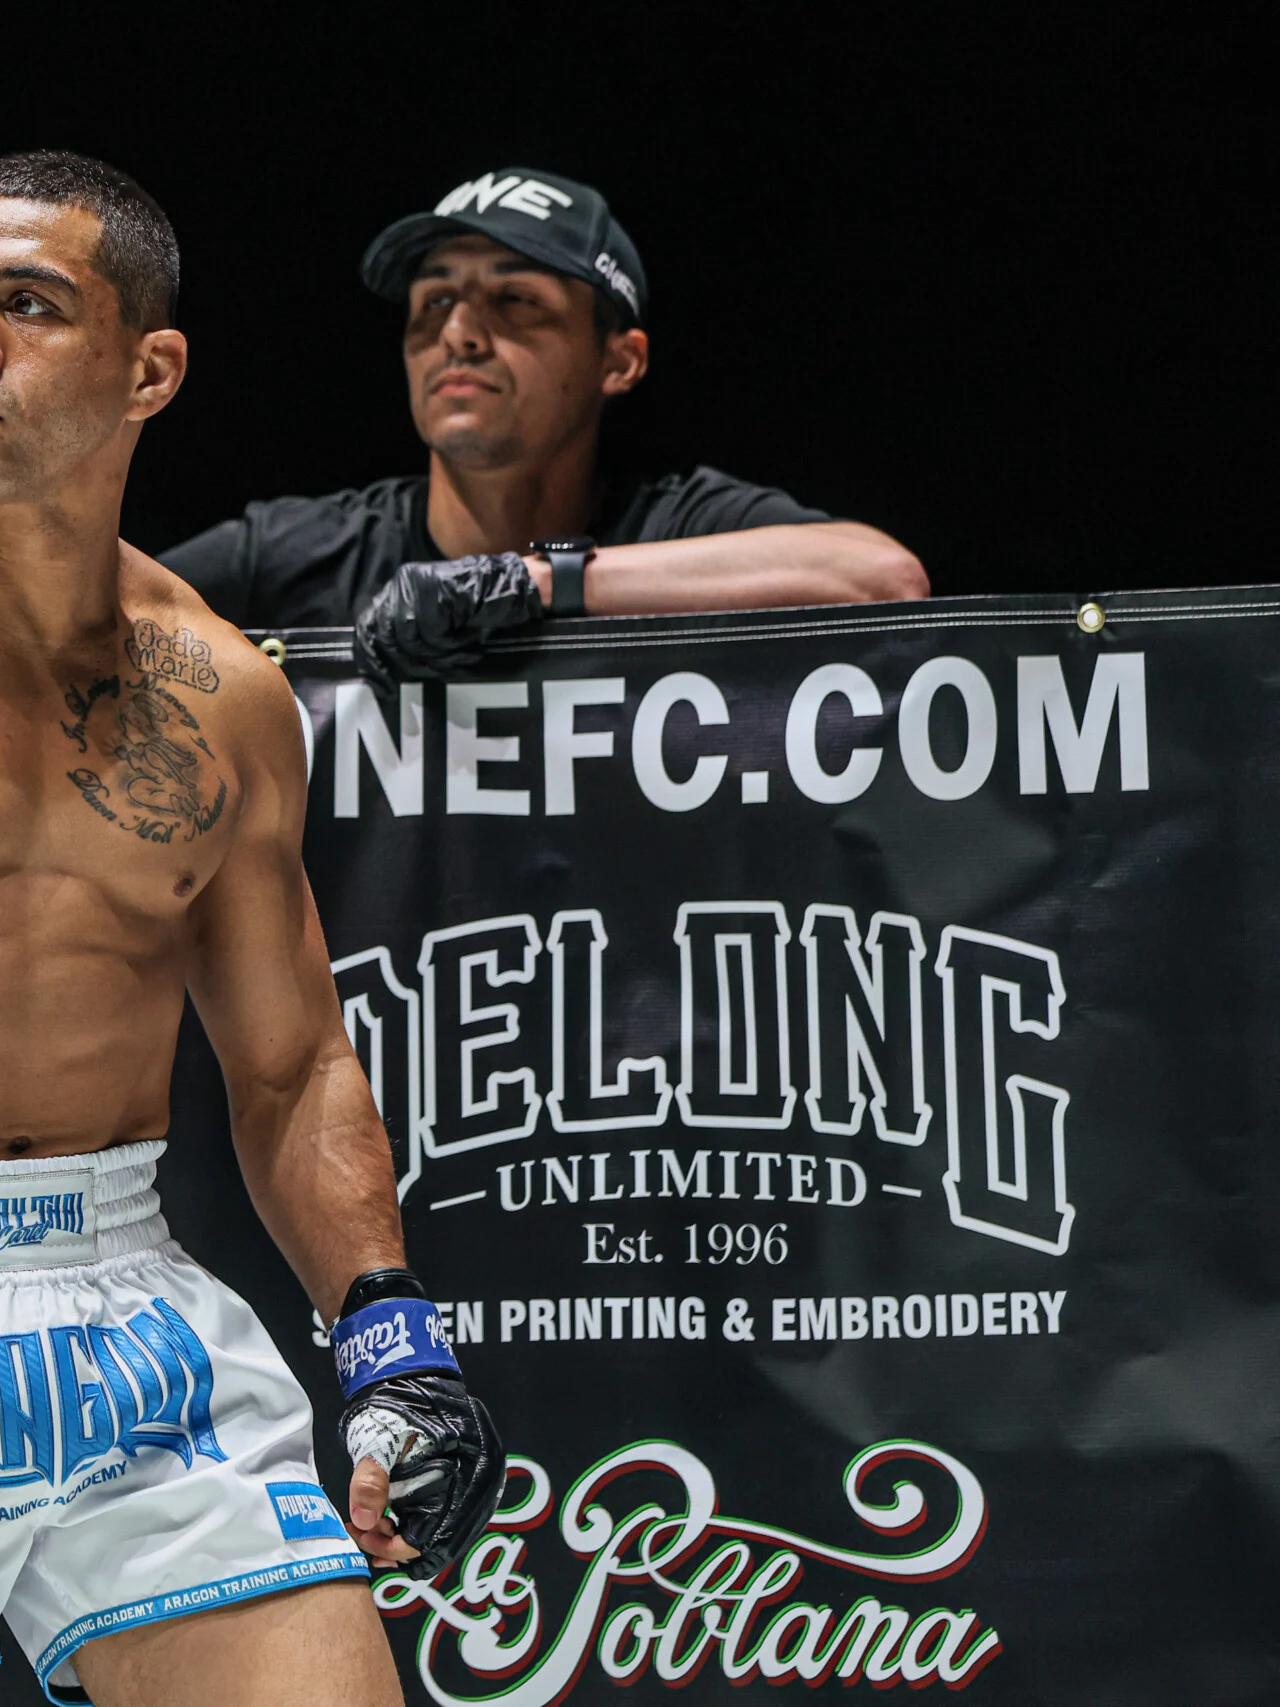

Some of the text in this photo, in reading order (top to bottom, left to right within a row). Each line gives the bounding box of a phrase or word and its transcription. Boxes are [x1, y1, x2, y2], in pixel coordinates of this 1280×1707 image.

[138, 646, 213, 687] Marie
[139, 622, 205, 664] Jade
[295, 652, 1149, 818] NEFC.COM
[496, 1149, 867, 1211] UNLIMITED
[582, 1222, 789, 1266] Est. 1996
[501, 1295, 707, 1344] PRINTING
[722, 1295, 754, 1343] &
[772, 1290, 1067, 1343] EMBROIDERY
[53, 1460, 127, 1506] ACADEMY
[417, 1438, 1002, 1707] Poblana
[55, 1619, 96, 1652] TRAINING
[96, 1601, 154, 1629] ACADEMY
[163, 1585, 220, 1611] ARAGON
[221, 1568, 290, 1595] TRAINING
[292, 1557, 347, 1580] ACADEMY
